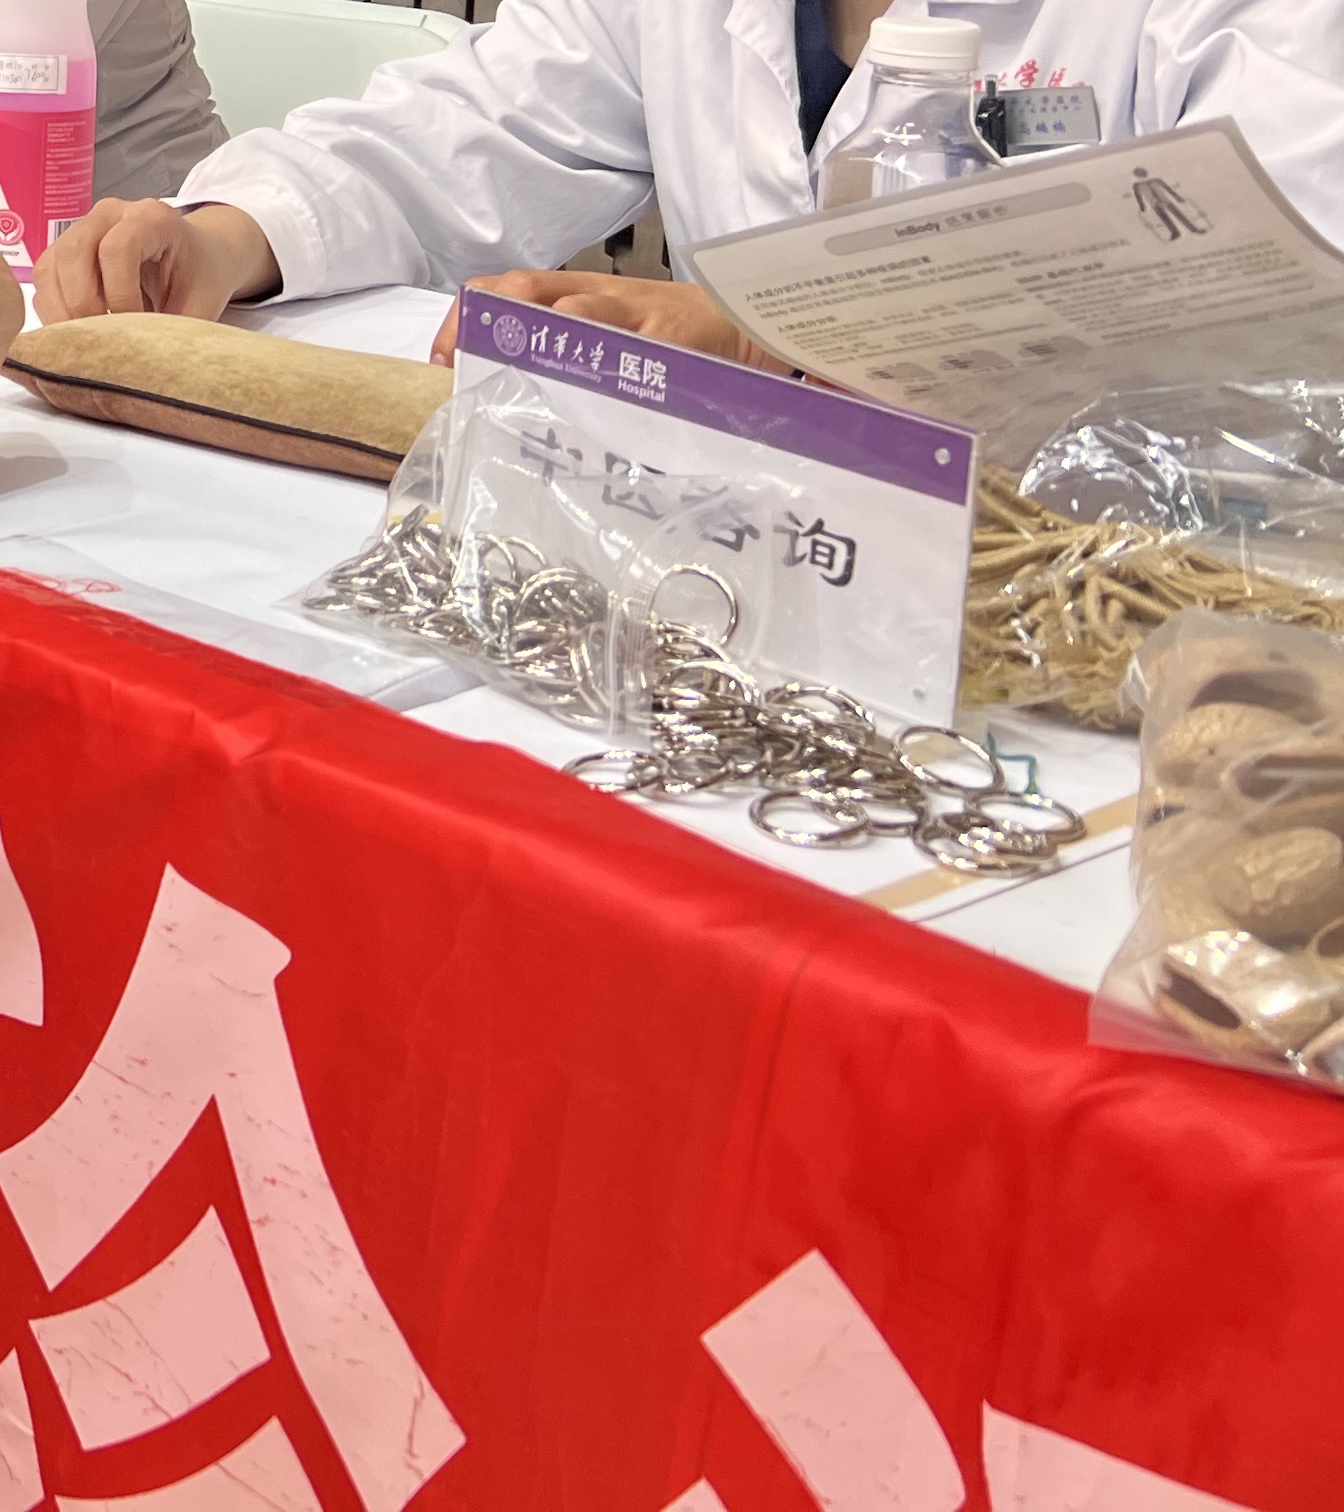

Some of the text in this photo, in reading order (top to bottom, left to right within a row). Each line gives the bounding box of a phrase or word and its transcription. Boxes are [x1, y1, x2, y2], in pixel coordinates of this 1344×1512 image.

[894, 221, 941, 238] InBody
[617, 351, 668, 389] 医院
[617, 378, 666, 403] Hospital
